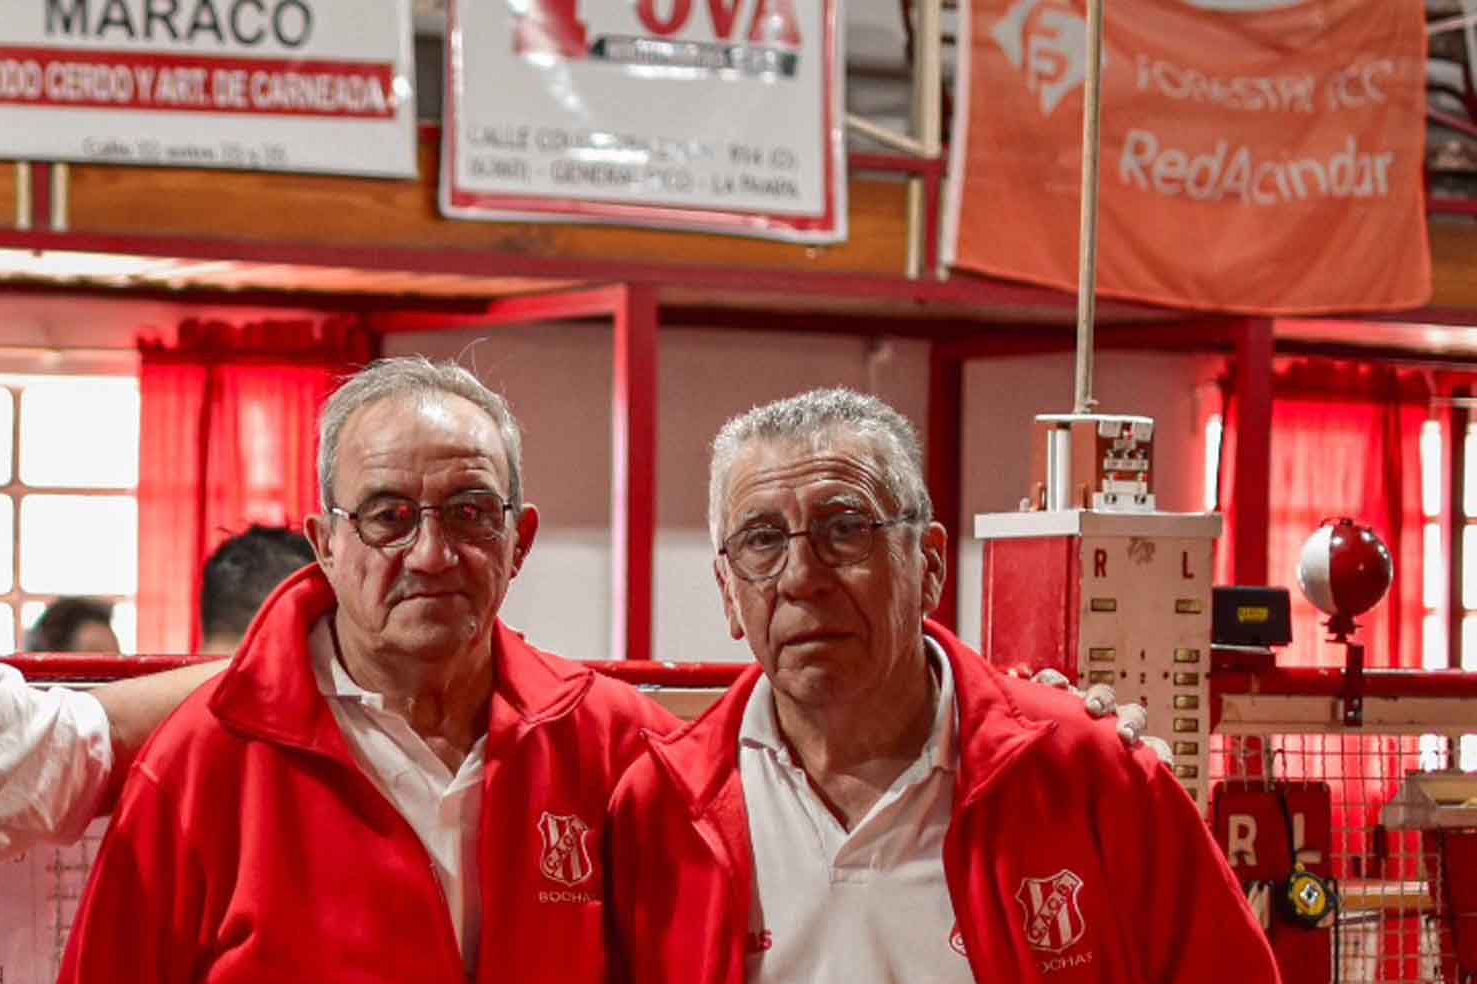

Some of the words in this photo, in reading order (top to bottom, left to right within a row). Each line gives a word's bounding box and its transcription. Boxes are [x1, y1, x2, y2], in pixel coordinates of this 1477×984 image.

[44, 0, 313, 48] MARACO
[45, 60, 134, 103] CERDO
[133, 65, 156, 103] Y
[213, 69, 248, 107] DE
[1094, 549, 1107, 579] R
[1182, 551, 1195, 580] L
[1228, 813, 1258, 867] R
[1293, 812, 1322, 864] L
[538, 890, 592, 904] BOCHA
